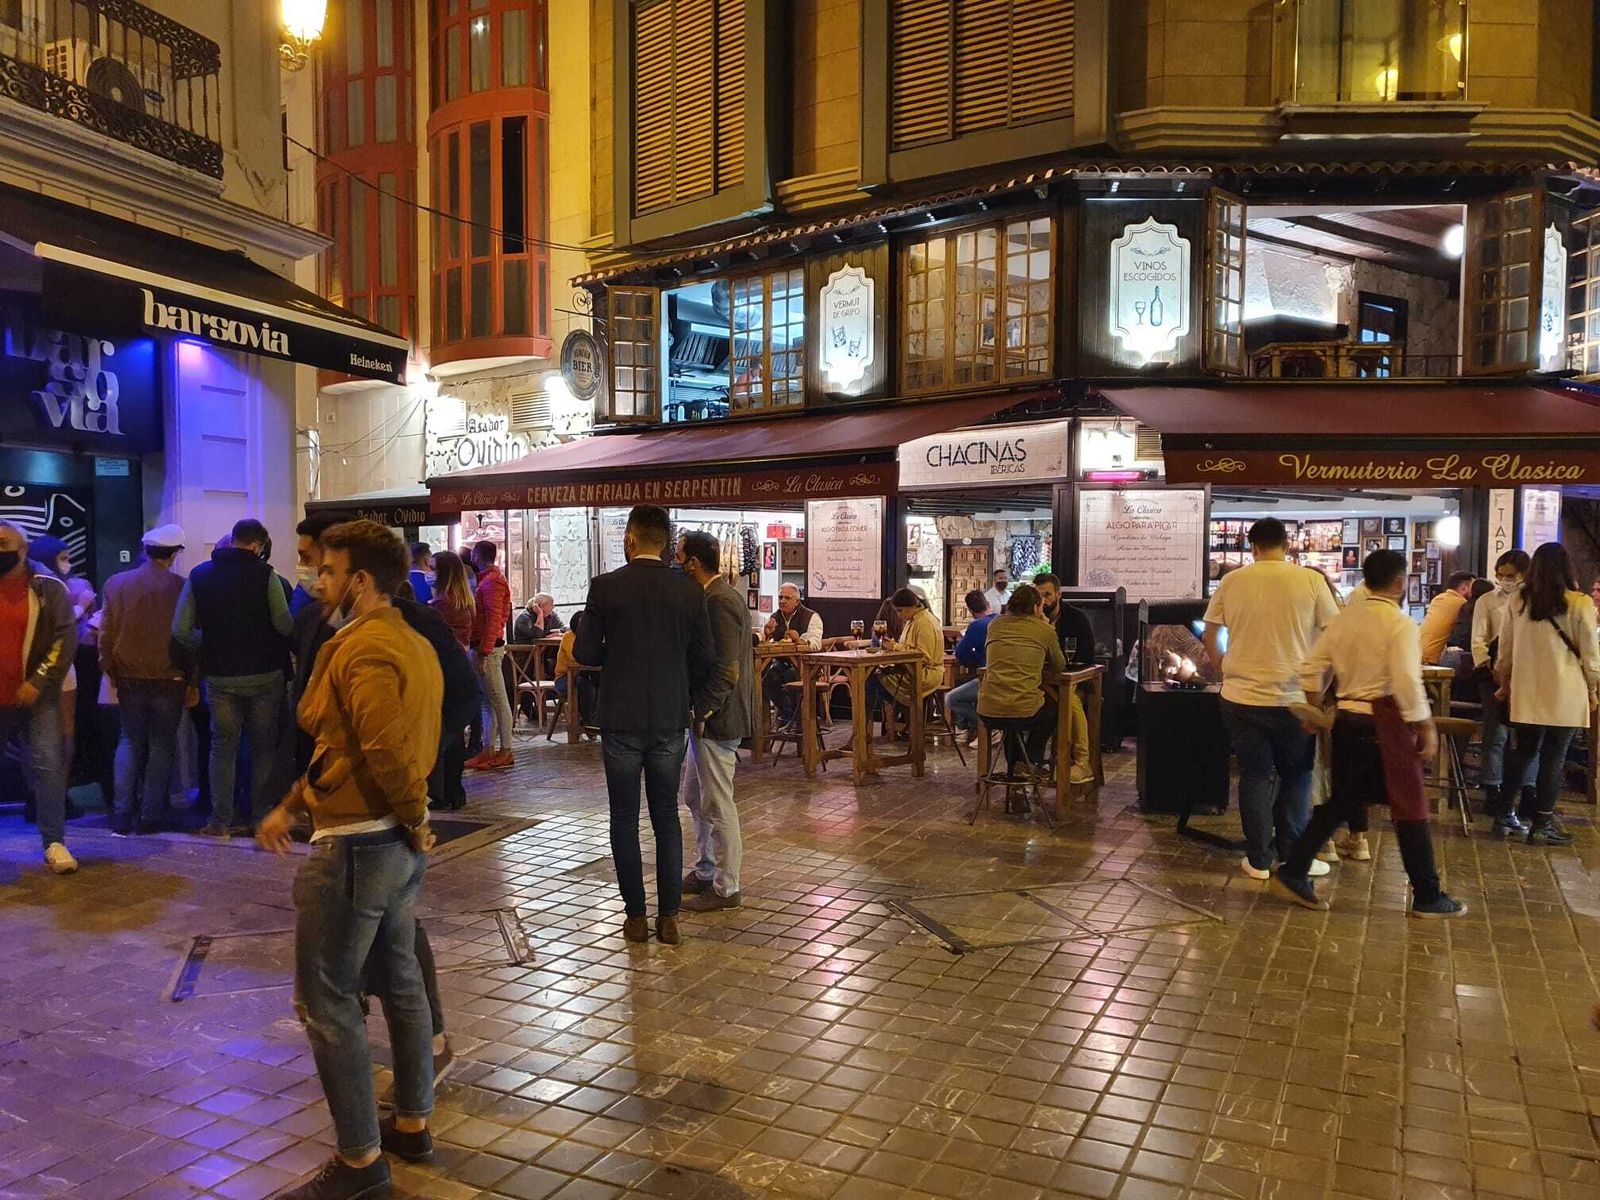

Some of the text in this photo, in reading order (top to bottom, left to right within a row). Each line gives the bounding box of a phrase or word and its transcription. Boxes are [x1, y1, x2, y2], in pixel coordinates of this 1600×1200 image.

[1133, 261, 1167, 271] VINOS
[1123, 272, 1177, 281] ESCOGIDOS
[833, 297, 860, 309] VERMUT
[140, 288, 291, 356] barsovia
[350, 353, 392, 373] Heineken
[573, 360, 592, 373] BIER
[468, 418, 504, 434] Asador
[926, 439, 1027, 467] CHACINAS
[1278, 454, 1585, 480] Vermuteria La Clasica
[527, 477, 743, 504] CERVEZA ENFRIADA EN SERPENTIN
[782, 473, 844, 494] La Clasica
[1106, 521, 1131, 530] ALGO
[1131, 521, 1155, 530] PARA
[1494, 507, 1506, 554] TAP
